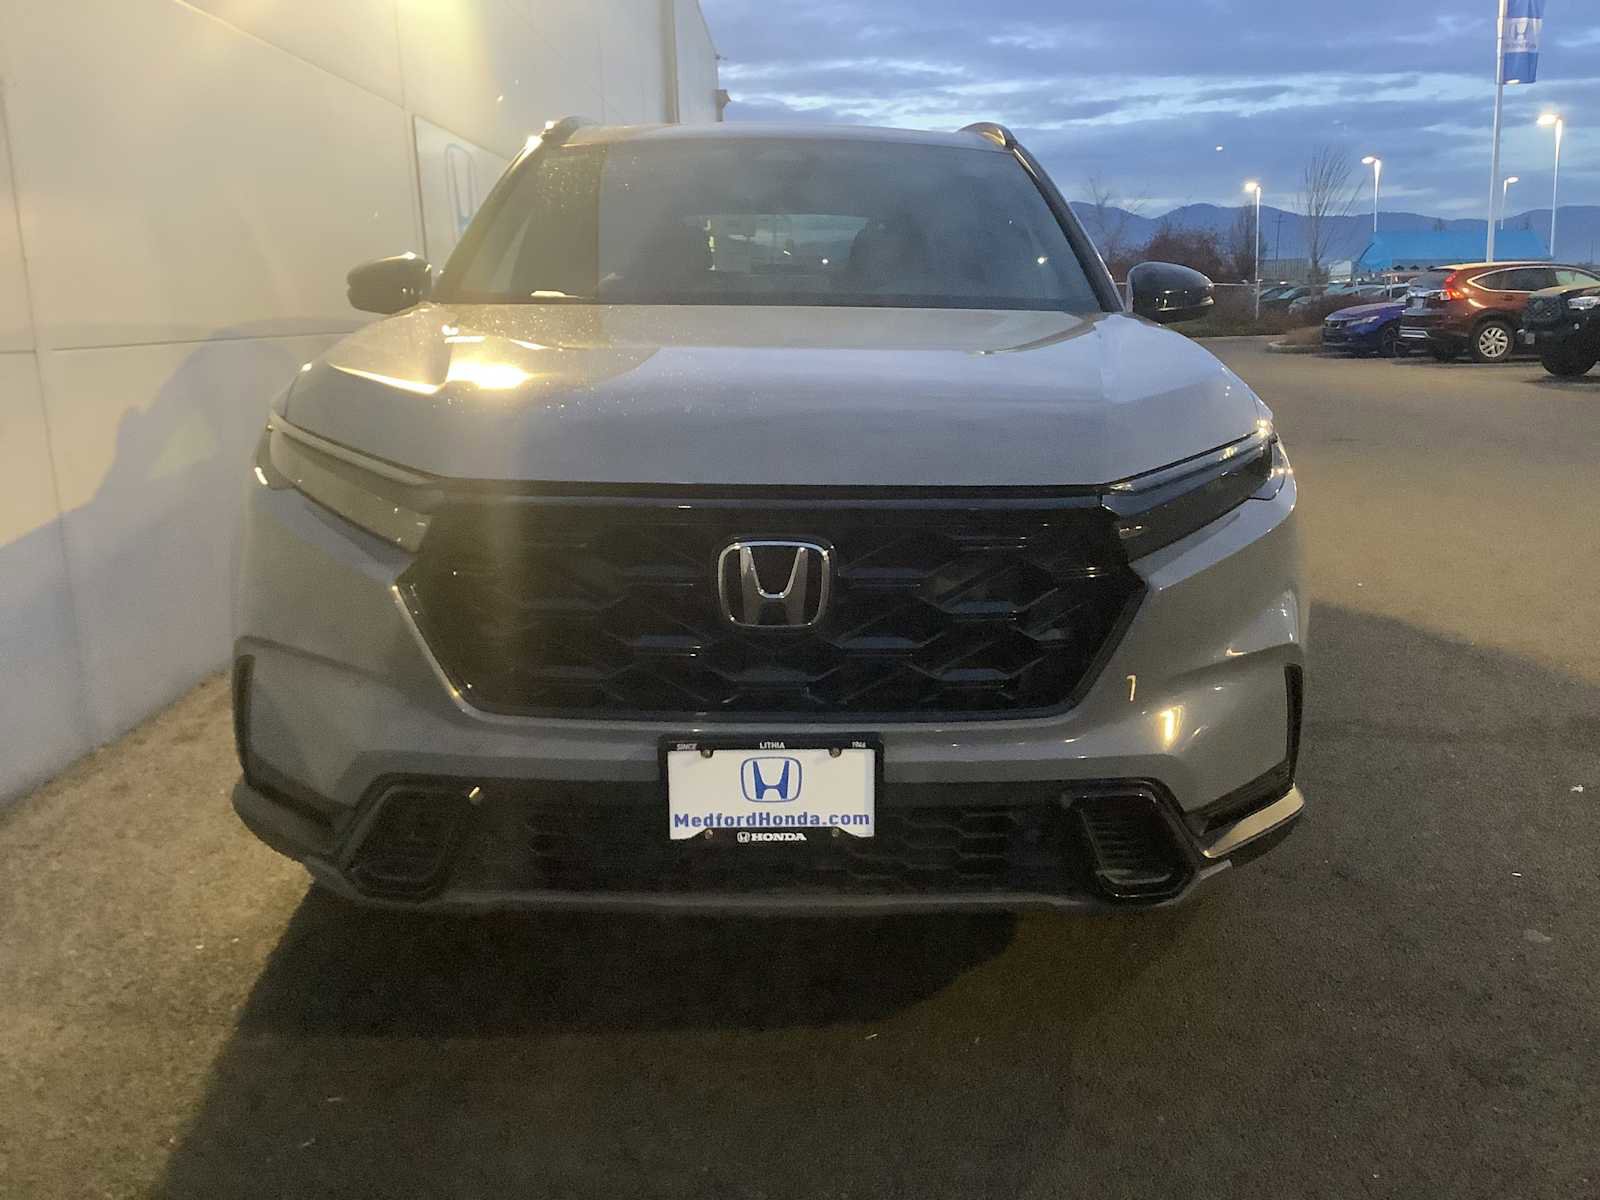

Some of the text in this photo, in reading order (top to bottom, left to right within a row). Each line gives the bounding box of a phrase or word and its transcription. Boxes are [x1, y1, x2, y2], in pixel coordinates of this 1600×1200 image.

[759, 741, 785, 749] LITHIA
[674, 812, 870, 828] MedfordHonda.com
[751, 832, 807, 841] HONDA
